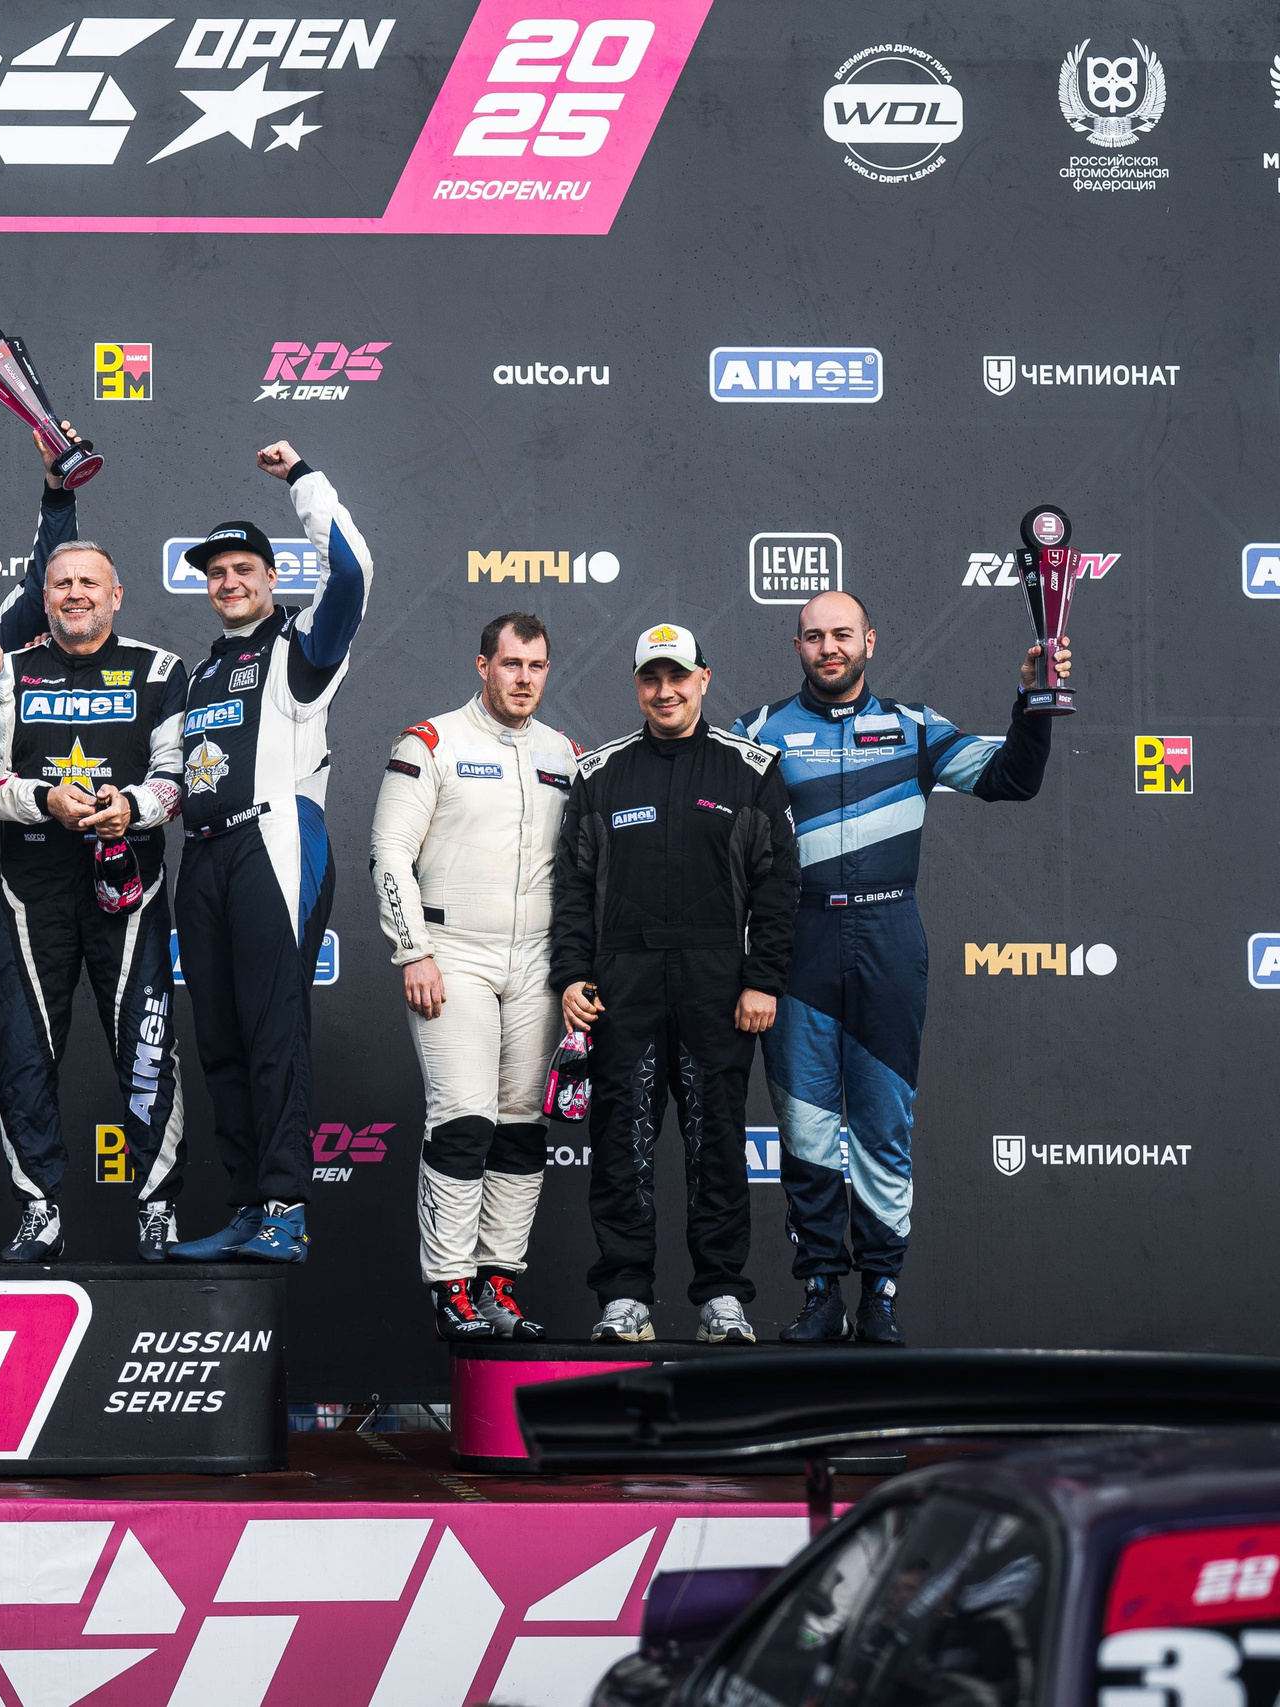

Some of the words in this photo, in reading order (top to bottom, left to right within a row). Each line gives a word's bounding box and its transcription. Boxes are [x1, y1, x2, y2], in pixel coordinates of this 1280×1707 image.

[175, 19, 396, 69] OPEN
[487, 19, 655, 82] 20
[834, 44, 893, 80] ВСЕМИРНАЯ
[893, 44, 933, 62] ДРИФТ
[930, 59, 953, 83] ЛИГА
[834, 102, 957, 125] WDL
[453, 93, 625, 156] 25
[843, 156, 878, 180] WORLD
[879, 173, 909, 183] DRIFT
[909, 155, 947, 181] LEAGUE
[1070, 154, 1158, 167] российская
[1059, 166, 1169, 178] автомобильная
[433, 181, 590, 200] RDSOPEN.RU
[1073, 178, 1156, 192] федерация
[264, 342, 392, 381] RDS
[493, 362, 609, 385] auto.ru
[718, 360, 875, 391] AIMOL
[1022, 365, 1180, 385] ЧЕМПИОНАТ
[292, 386, 350, 400] OPEN
[763, 547, 829, 573] LEVEL
[763, 577, 829, 590] KITCHEN
[234, 668, 255, 682] LEVEL
[26, 696, 132, 716] AIMOL
[186, 706, 240, 732] AIMOL
[582, 757, 602, 770] OMP
[746, 751, 767, 764] OMP
[461, 764, 500, 776] AIMOL
[226, 805, 262, 828] A.RYABOV
[615, 809, 654, 825] AIMOL
[854, 889, 904, 902] G.BIBAEV
[130, 992, 168, 1126] AIMOL
[1032, 1145, 1191, 1165] ЧЕМПИОНАТ
[312, 1168, 353, 1181] PEN
[131, 1331, 272, 1353] RUSSIAN
[118, 1362, 220, 1382] DRIFT
[104, 1391, 225, 1412] SERIES
